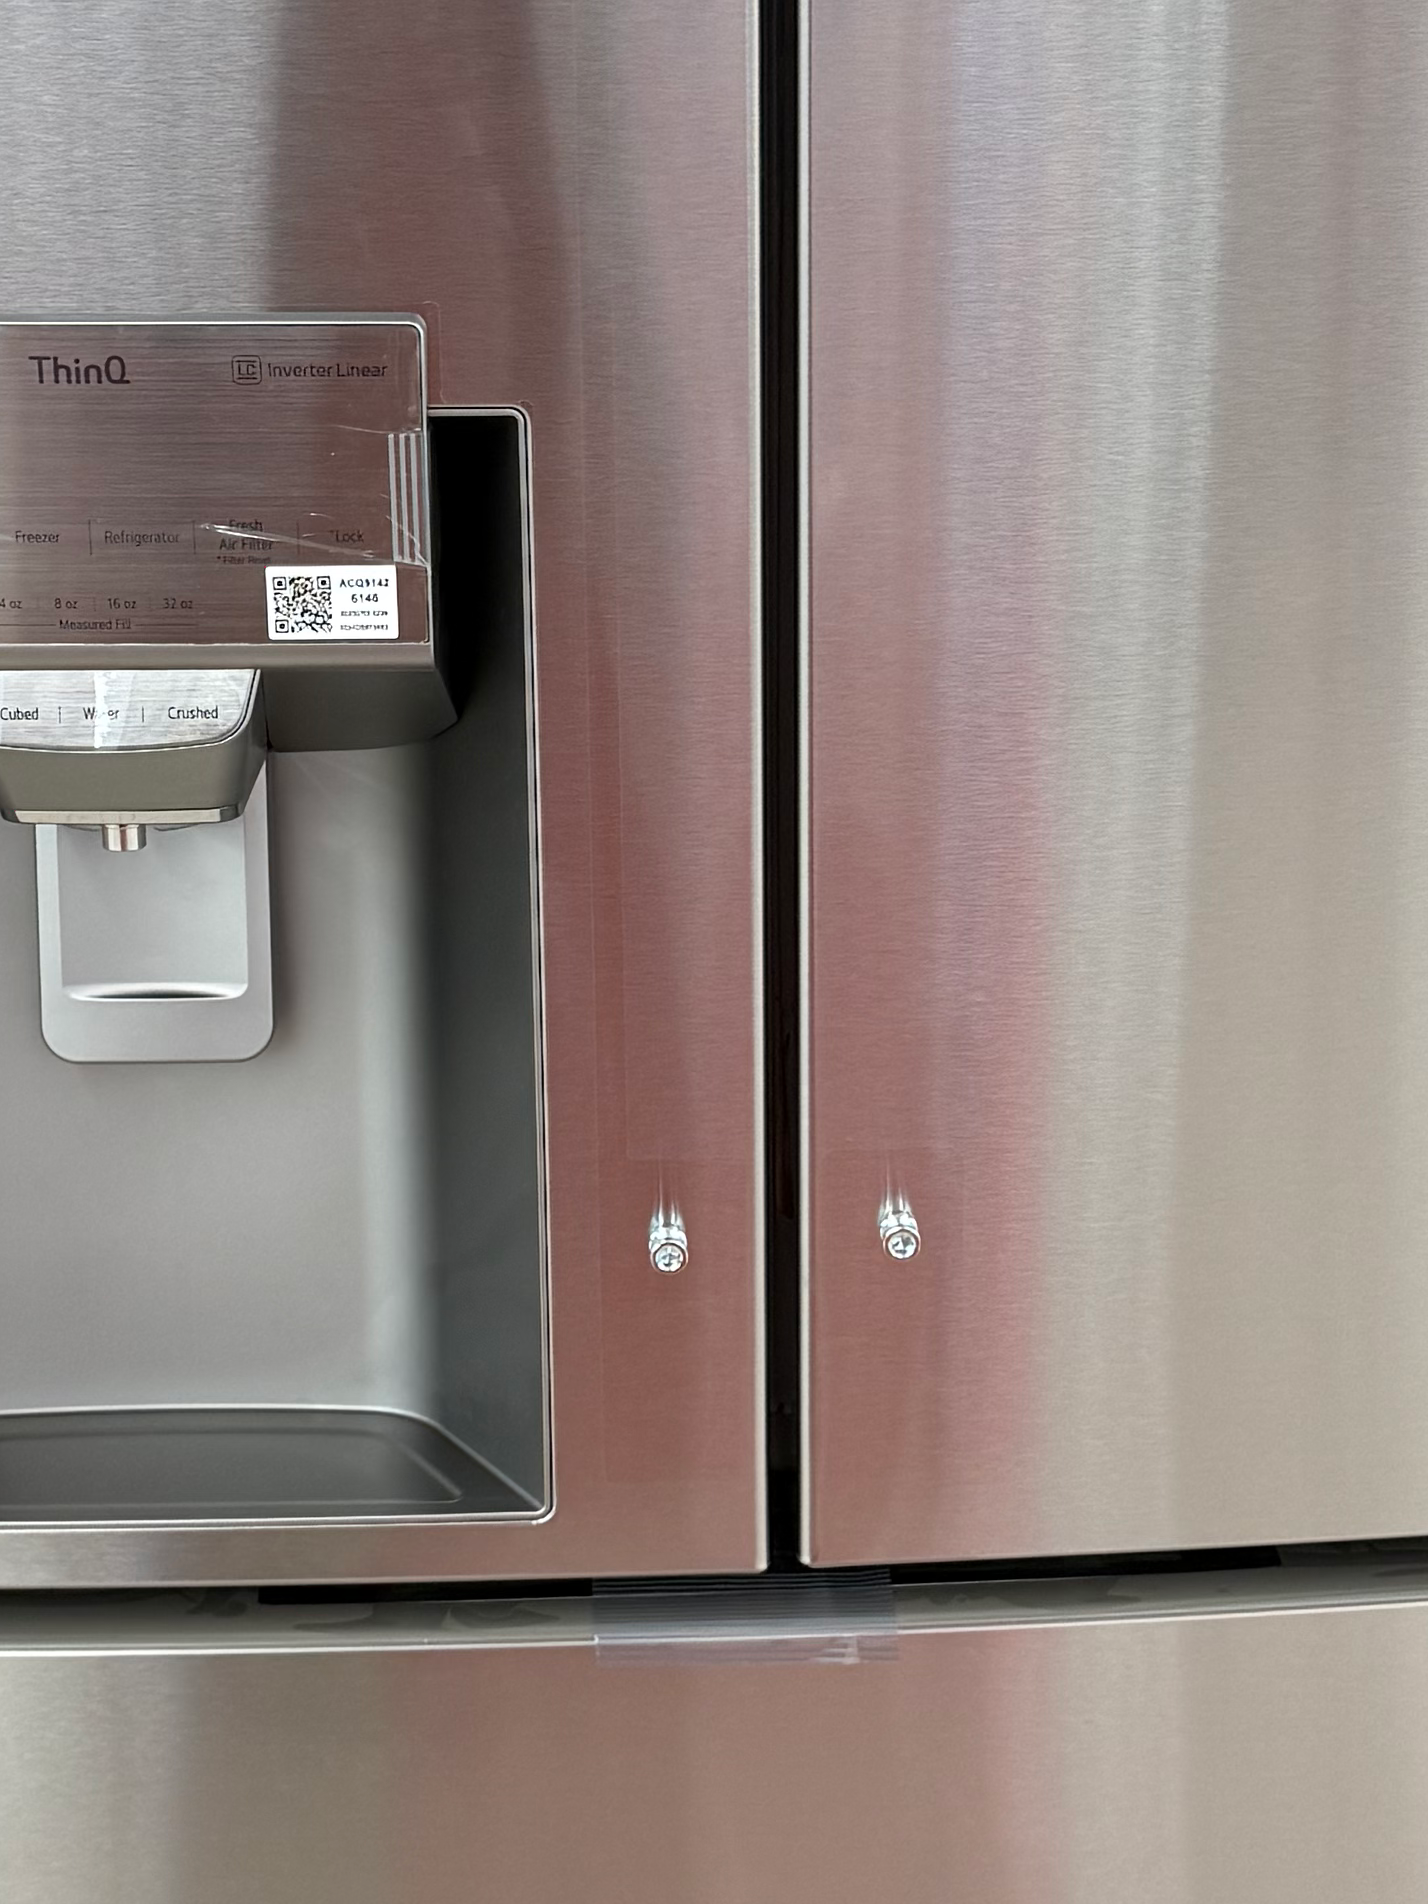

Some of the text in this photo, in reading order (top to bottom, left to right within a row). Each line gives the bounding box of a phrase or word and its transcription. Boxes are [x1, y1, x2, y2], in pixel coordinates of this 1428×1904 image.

[28, 355, 131, 385] ThinQ
[268, 363, 333, 378] Inverter
[336, 363, 388, 378] Linear
[229, 518, 263, 532] Fresh
[15, 529, 60, 544] Freezer
[104, 530, 180, 547] Refrigerator
[219, 538, 273, 551] Air Filter
[9, 600, 23, 609] oz
[54, 598, 79, 609] 8 oz
[108, 598, 137, 609] 16 oz
[163, 598, 193, 609] 32 oz
[59, 619, 132, 630] Measured Fill
[0, 707, 39, 721] Cubed
[168, 706, 219, 720] Crushed
